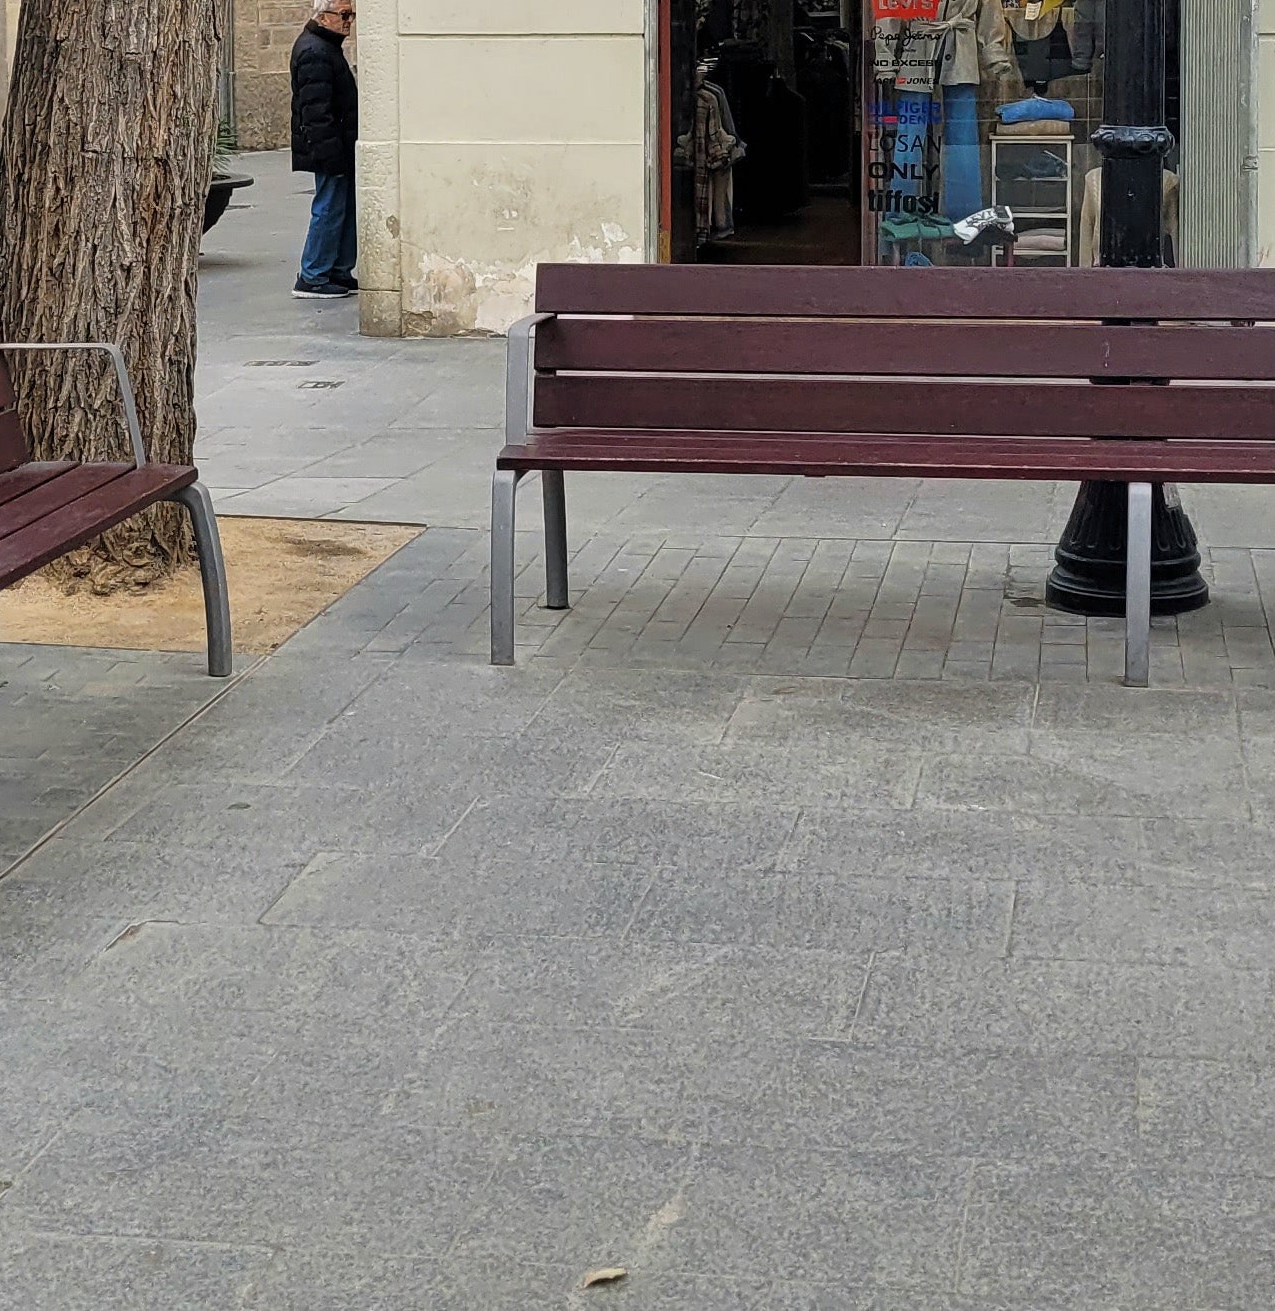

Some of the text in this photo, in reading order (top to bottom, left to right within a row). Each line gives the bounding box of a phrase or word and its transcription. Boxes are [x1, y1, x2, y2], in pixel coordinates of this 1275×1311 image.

[871, 26, 900, 46] Pepe
[869, 134, 942, 154] LOSAN
[868, 161, 940, 180] ONLY
[868, 190, 940, 214] tiffosi
